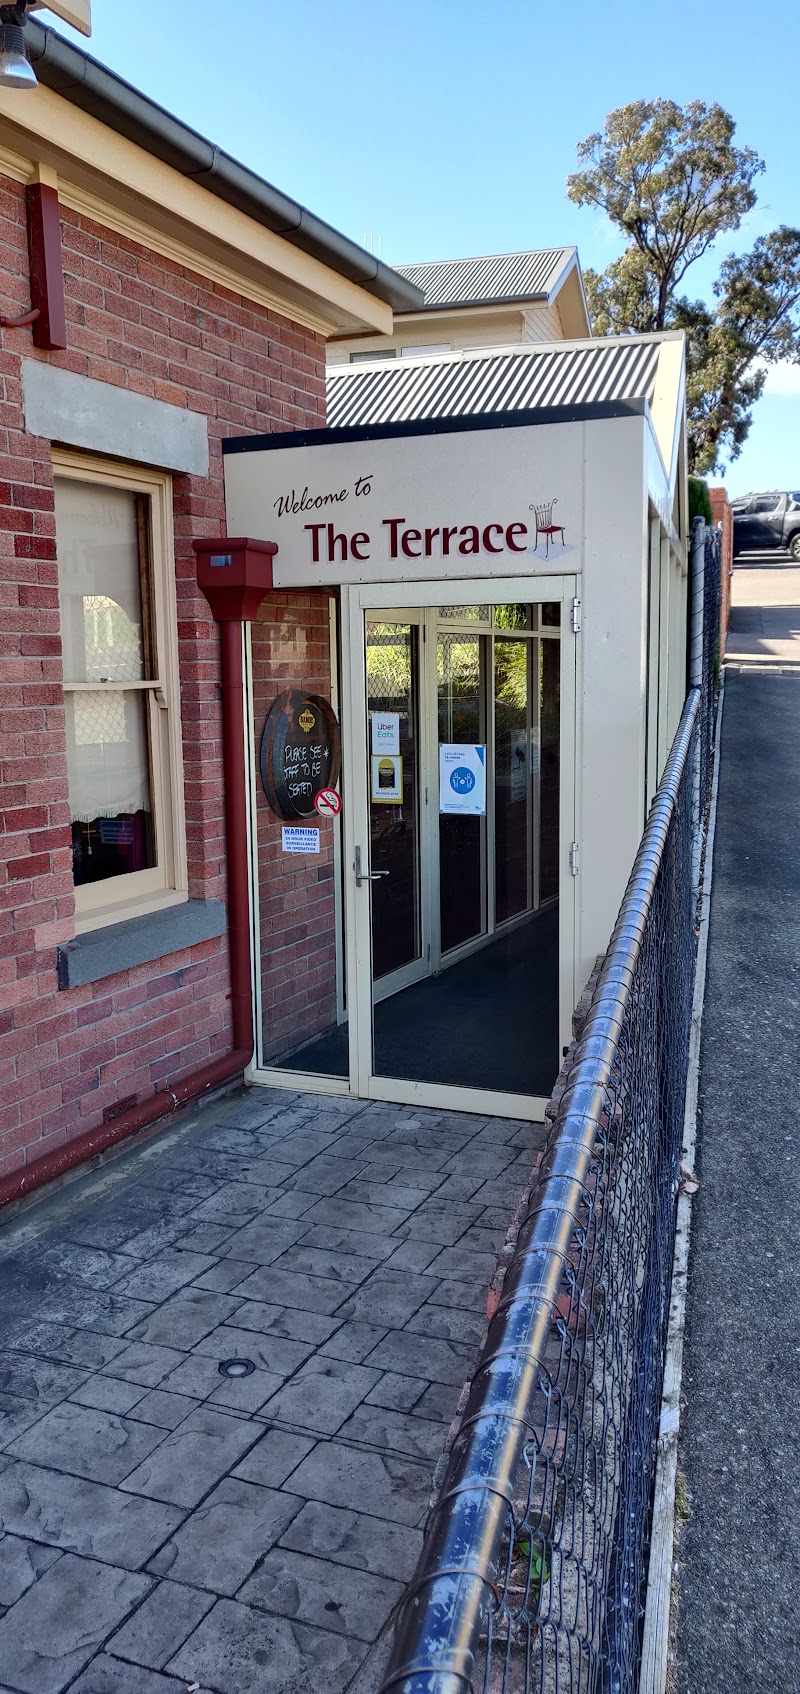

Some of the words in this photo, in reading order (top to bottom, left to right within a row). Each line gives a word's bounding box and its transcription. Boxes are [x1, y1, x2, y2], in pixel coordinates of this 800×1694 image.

[273, 486, 349, 518] Welcome
[354, 475, 374, 496] to
[304, 523, 371, 562] The
[382, 518, 528, 558] Terrace
[377, 723, 394, 731] Uber
[284, 745, 307, 763] PLEASE
[310, 745, 322, 760] SEE
[301, 762, 310, 776] TO
[311, 762, 321, 777] BE
[288, 782, 313, 798] SEATED
[283, 828, 318, 836] WARNING
